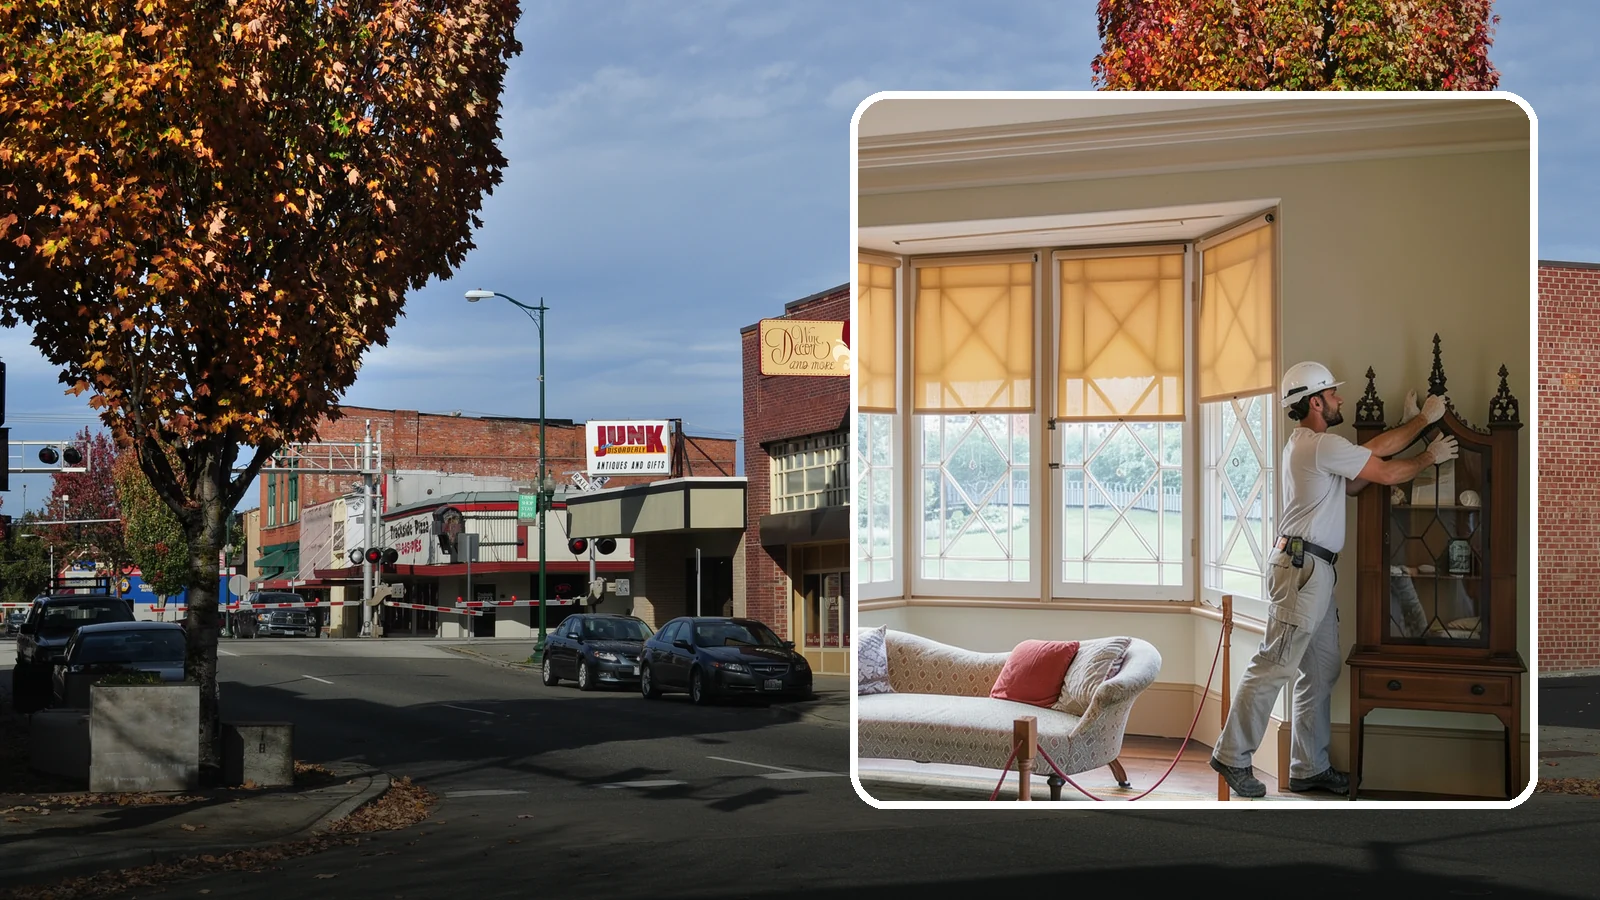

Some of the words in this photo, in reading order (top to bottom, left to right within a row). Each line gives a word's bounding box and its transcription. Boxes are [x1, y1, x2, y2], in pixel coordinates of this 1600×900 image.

[595, 425, 665, 457] JUNK
[607, 446, 646, 454] DISORDERLY
[597, 461, 628, 470] ANTIQUES
[631, 461, 644, 470] AND
[647, 460, 665, 470] GIFTS
[573, 474, 588, 492] RAIL
